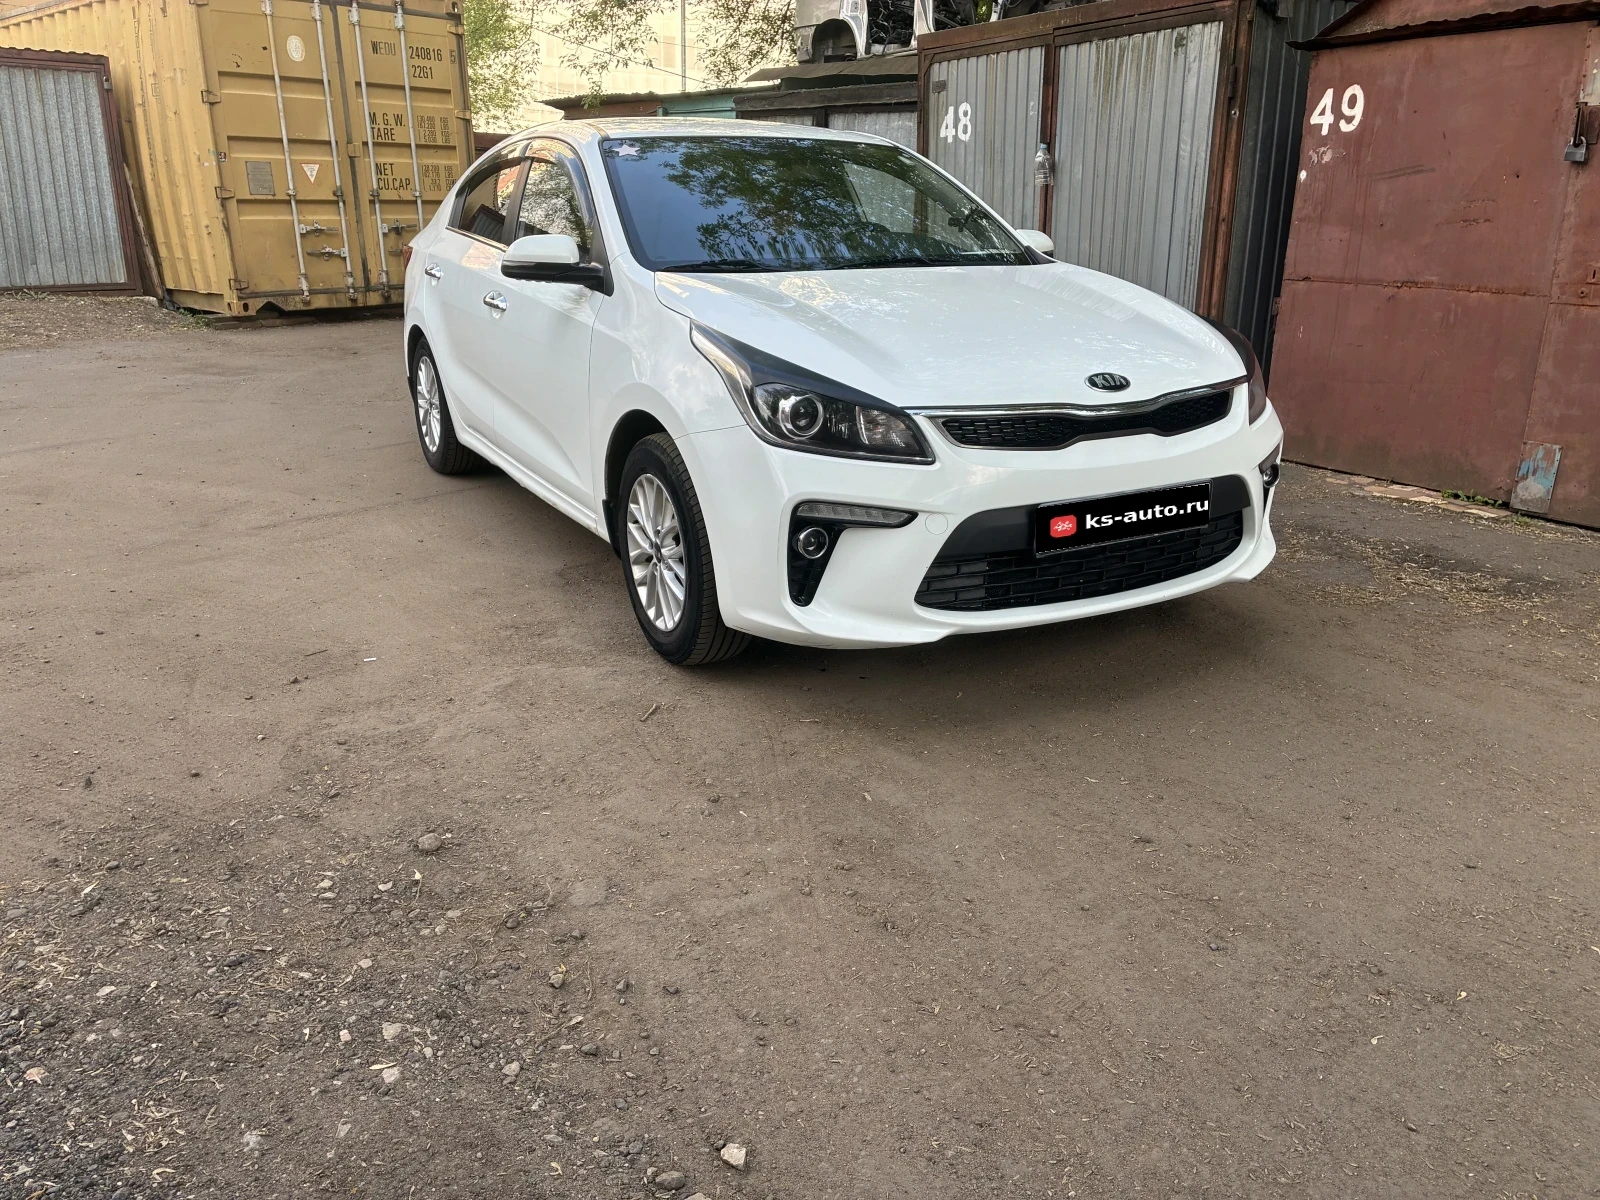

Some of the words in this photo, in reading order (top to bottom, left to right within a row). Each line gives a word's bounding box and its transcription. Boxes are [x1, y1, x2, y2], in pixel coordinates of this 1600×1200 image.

[371, 40, 396, 56] WEDU
[408, 46, 443, 62] 240816
[450, 50, 457, 64] 5
[411, 65, 434, 80] 22G1
[1310, 84, 1365, 136] 49
[940, 102, 972, 143] 48
[371, 127, 396, 141] TARE
[376, 163, 394, 176] NET
[1091, 374, 1127, 388] KIA
